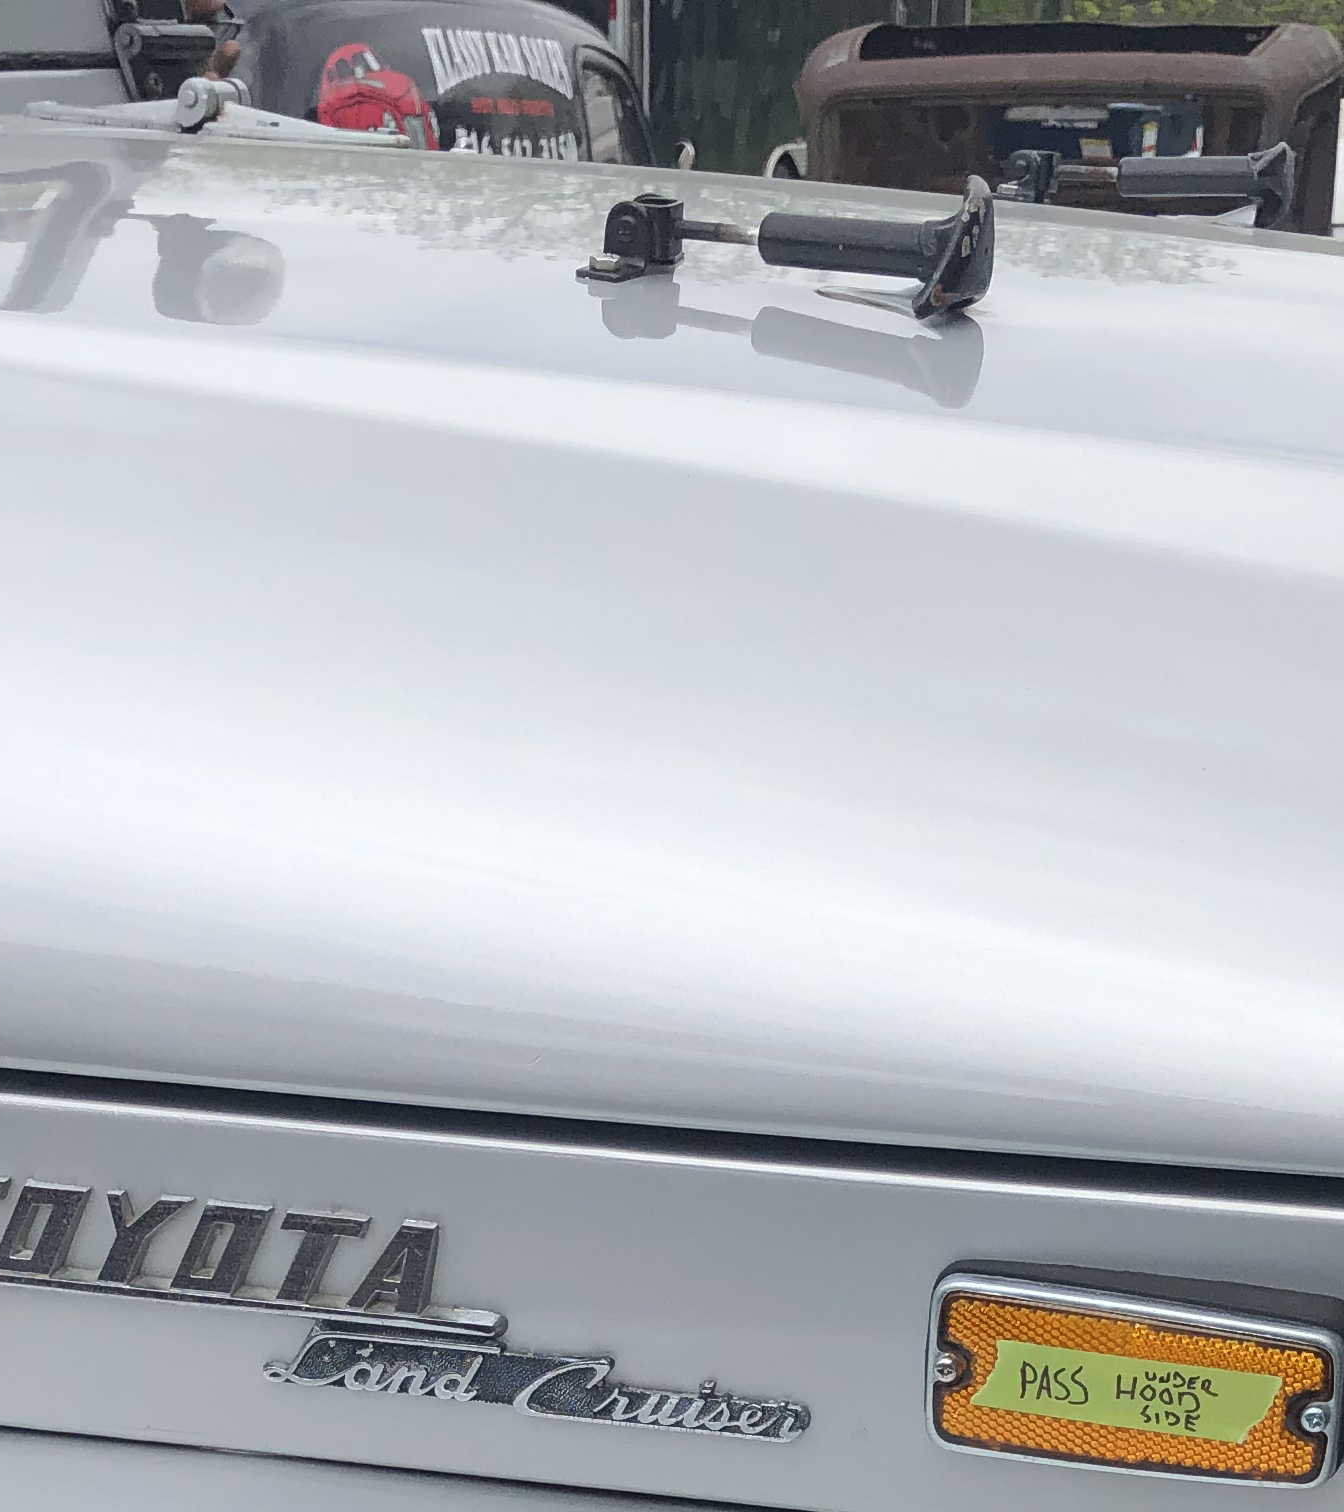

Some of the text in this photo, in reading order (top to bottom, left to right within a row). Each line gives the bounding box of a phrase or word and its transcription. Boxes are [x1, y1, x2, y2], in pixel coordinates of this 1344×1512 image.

[262, 1338, 802, 1438] Land Cruiser
[1019, 1360, 1201, 1413] PASS HOOD
[1144, 1371, 1219, 1398] UNDER
[1139, 1408, 1201, 1432] SIDE
